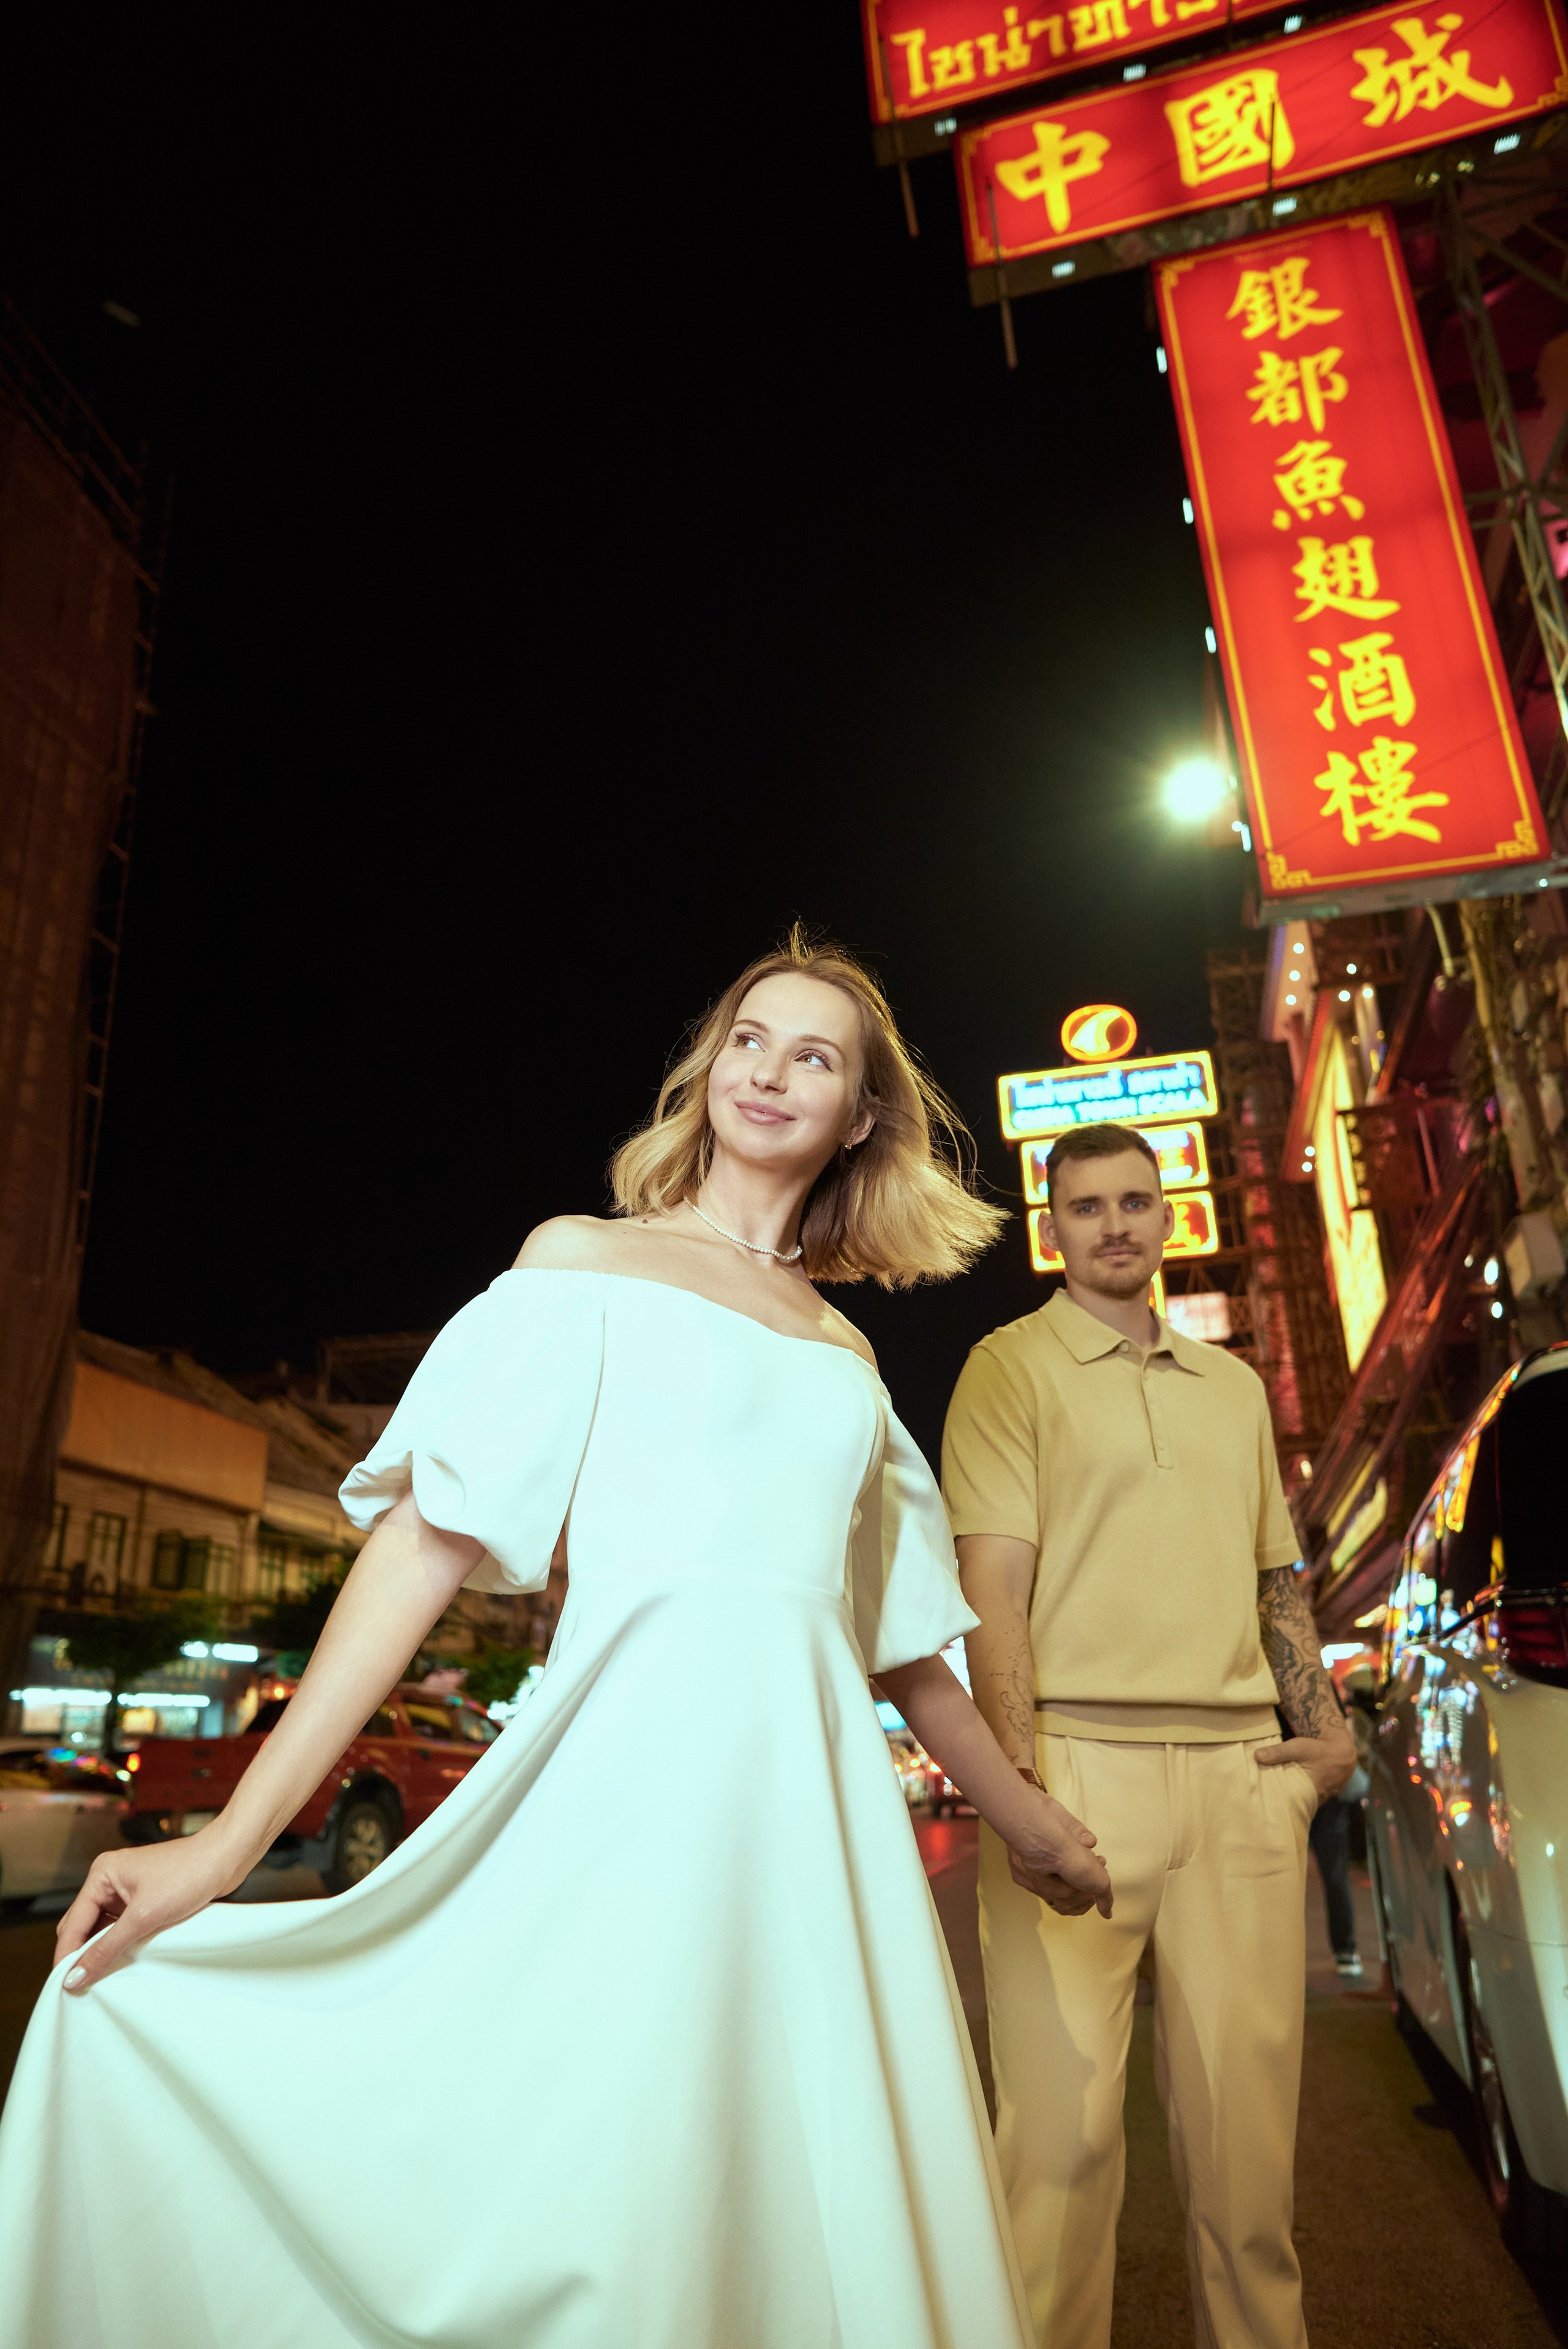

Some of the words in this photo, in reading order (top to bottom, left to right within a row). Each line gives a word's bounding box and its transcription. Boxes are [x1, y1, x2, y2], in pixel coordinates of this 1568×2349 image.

[995, 12, 1514, 234] 中國城
[1226, 257, 1450, 847] 銀都魚翅酒樓
